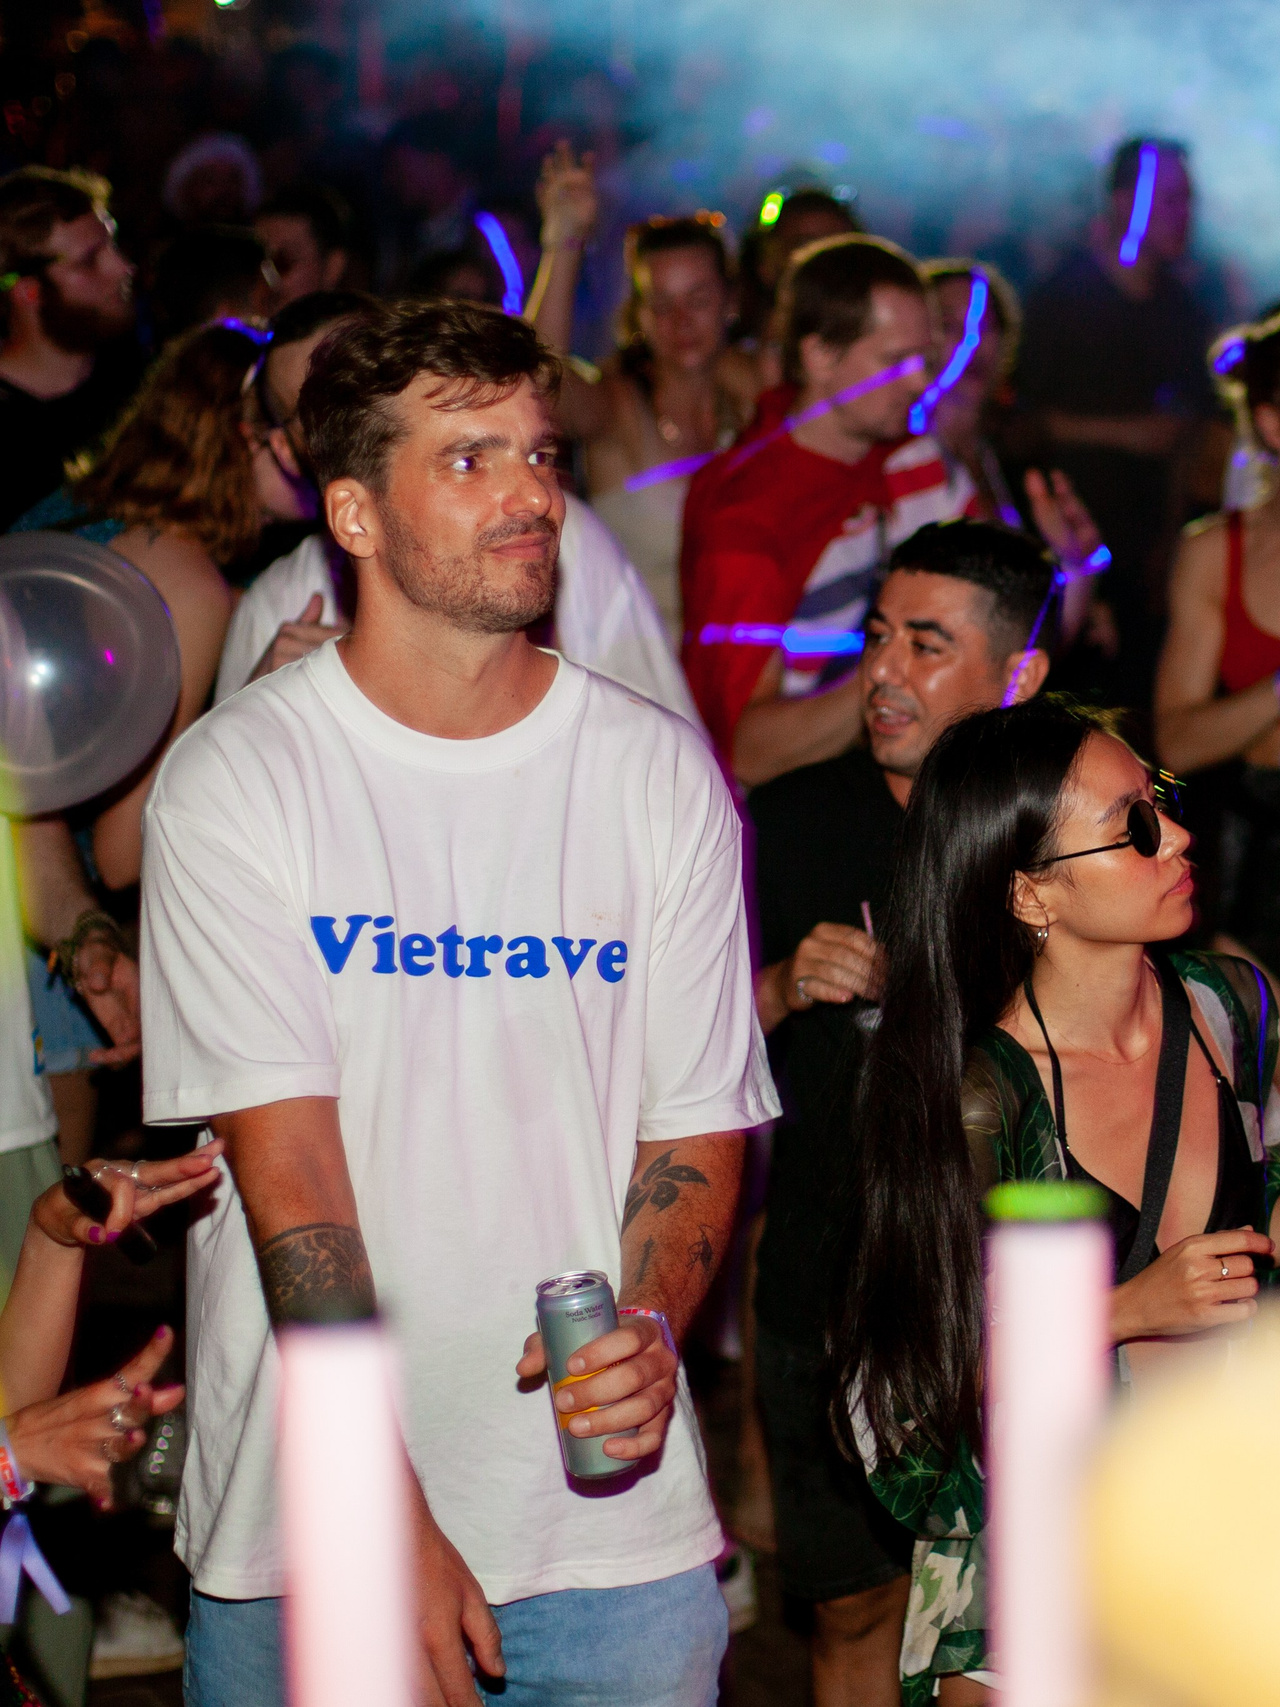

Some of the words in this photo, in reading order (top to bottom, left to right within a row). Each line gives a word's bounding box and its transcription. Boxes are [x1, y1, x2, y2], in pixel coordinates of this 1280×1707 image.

[310, 914, 628, 984] Vietrave
[565, 1310, 583, 1319] Soda
[584, 1303, 604, 1314] Water
